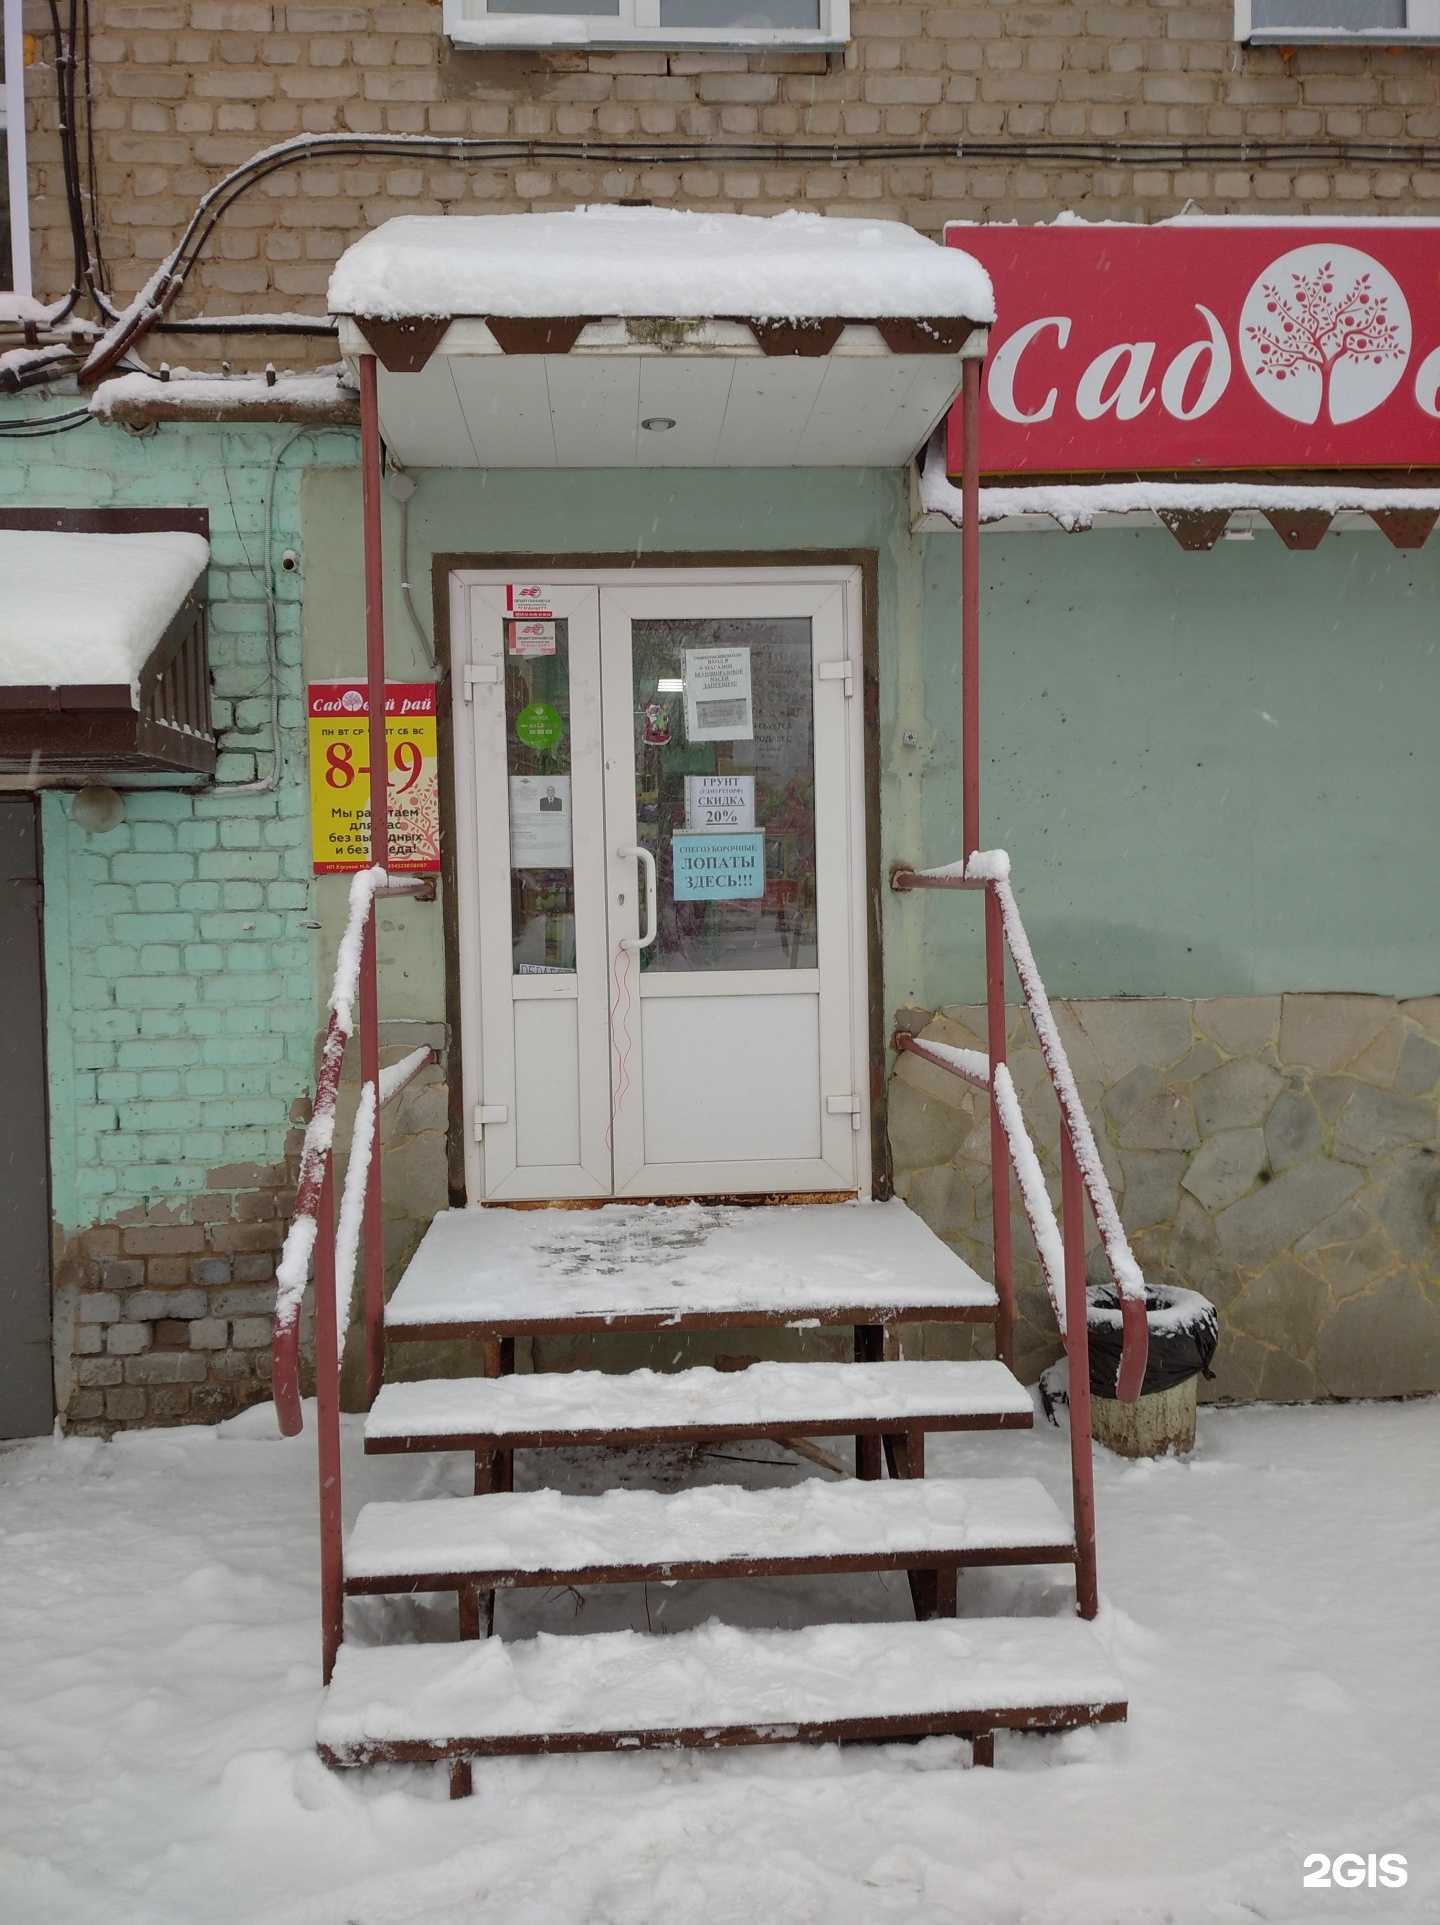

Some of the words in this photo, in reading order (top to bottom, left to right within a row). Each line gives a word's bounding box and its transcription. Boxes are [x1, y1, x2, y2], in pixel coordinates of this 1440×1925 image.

[400, 698, 432, 714] рай
[703, 778, 740, 787] ГРУНТ
[697, 797, 745, 806] СКИДКА
[331, 808, 352, 818] Мы
[356, 808, 419, 820] ратаем
[705, 810, 738, 824] 20%
[388, 822, 401, 830] ас
[329, 833, 351, 843] без
[355, 833, 423, 845] выдных
[335, 846, 343, 854] и
[347, 844, 369, 854] без
[389, 843, 417, 856] еда!
[681, 856, 755, 871] ЛОПАТЫ
[687, 874, 753, 889] ЗДЕСЬ!!!
